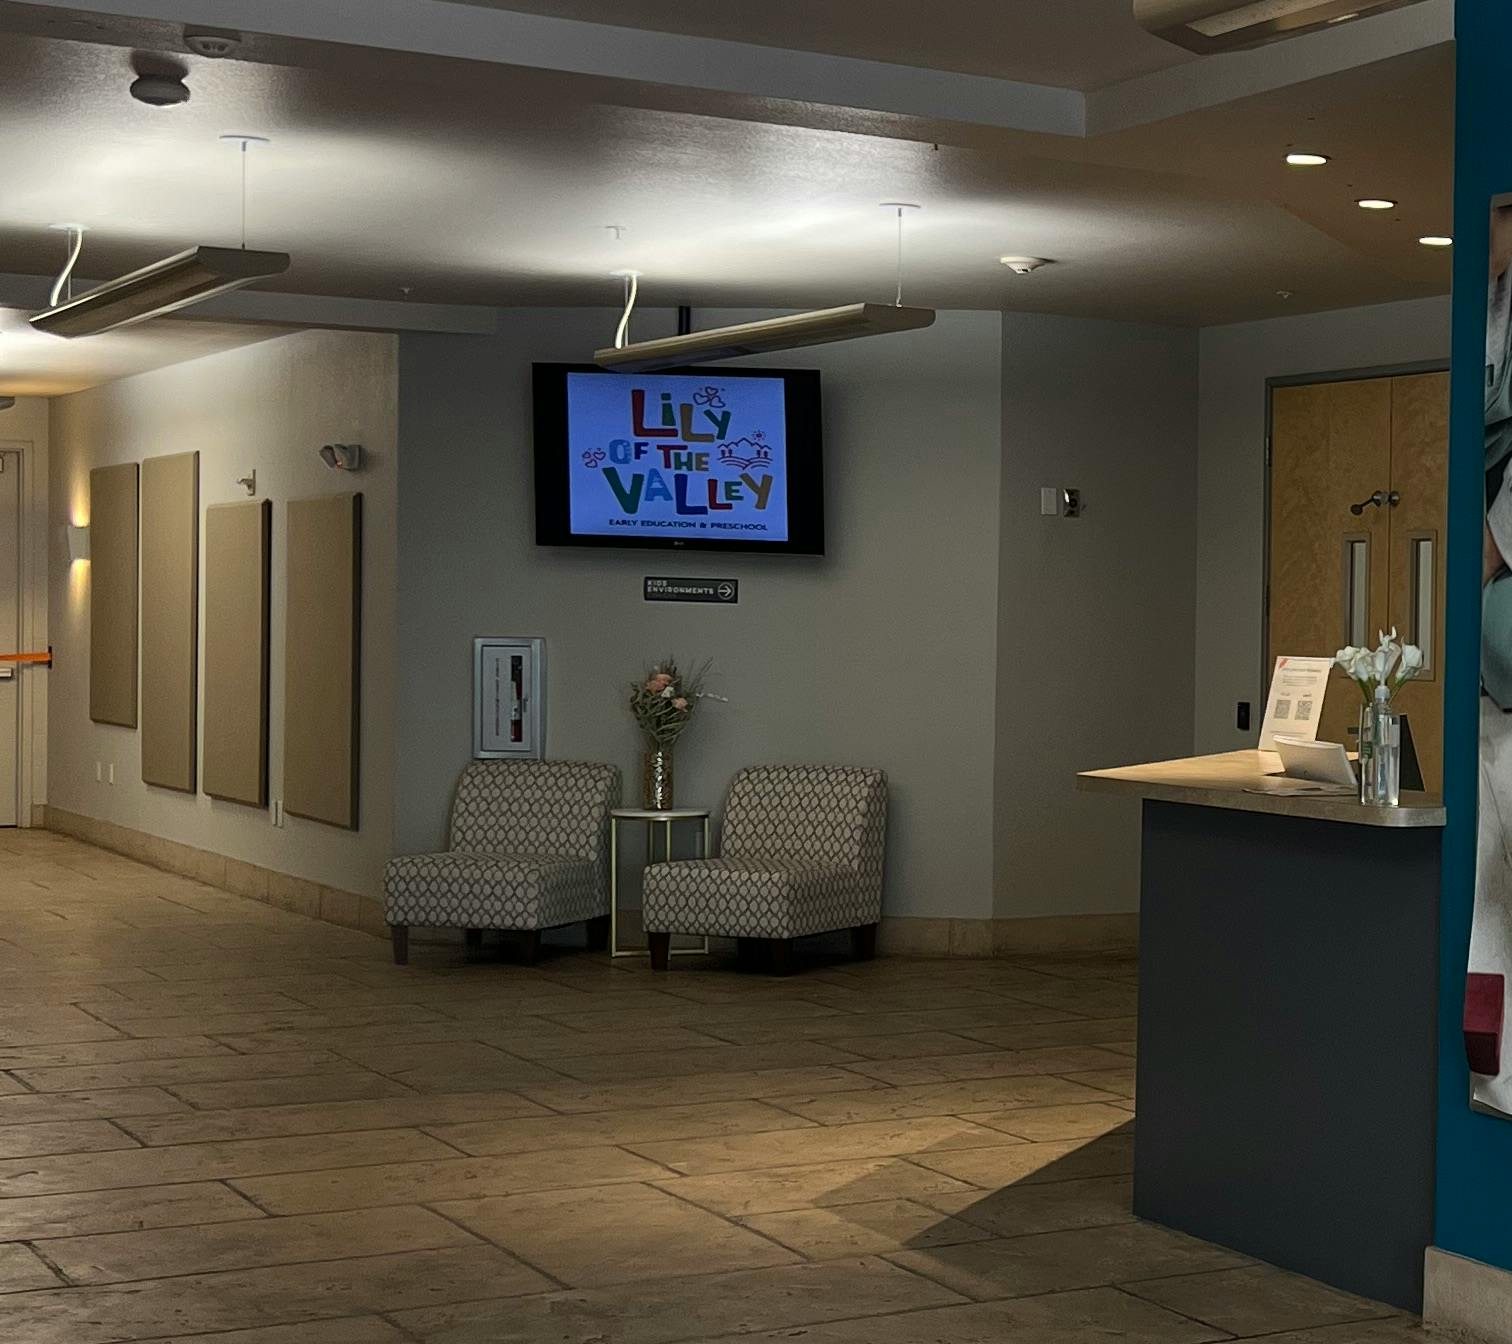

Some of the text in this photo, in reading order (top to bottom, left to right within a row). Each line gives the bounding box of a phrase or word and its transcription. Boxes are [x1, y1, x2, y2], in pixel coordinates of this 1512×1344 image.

[608, 439, 710, 471] OF THE
[602, 467, 773, 515] VALLEY
[608, 519, 638, 527] EARLY
[640, 519, 696, 529] EDUCATION
[710, 521, 768, 531] PRESCHOOL
[647, 586, 714, 595] ENVIRONMENTS
